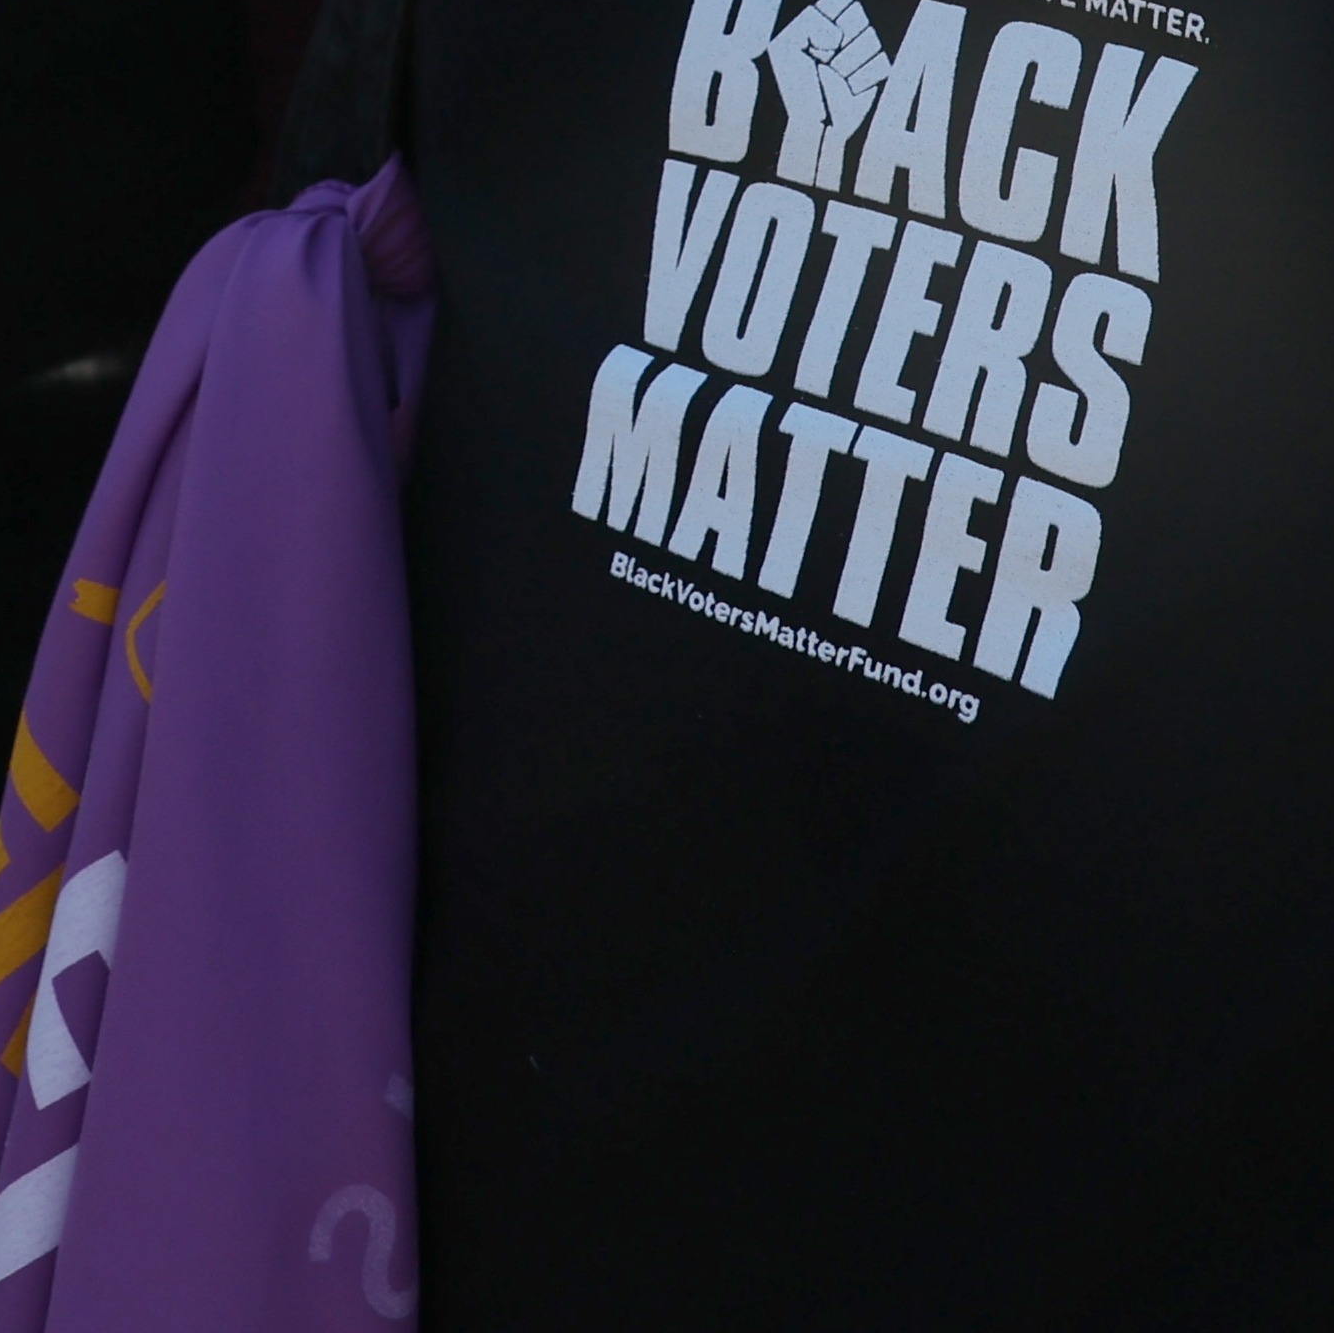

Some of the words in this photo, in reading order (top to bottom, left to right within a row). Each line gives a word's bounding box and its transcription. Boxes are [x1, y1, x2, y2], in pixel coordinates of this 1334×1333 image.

[643, 158, 1153, 489] VOTERS
[571, 343, 1103, 700] MATTER
[609, 551, 981, 724] BlackVotersMatterFund.org
